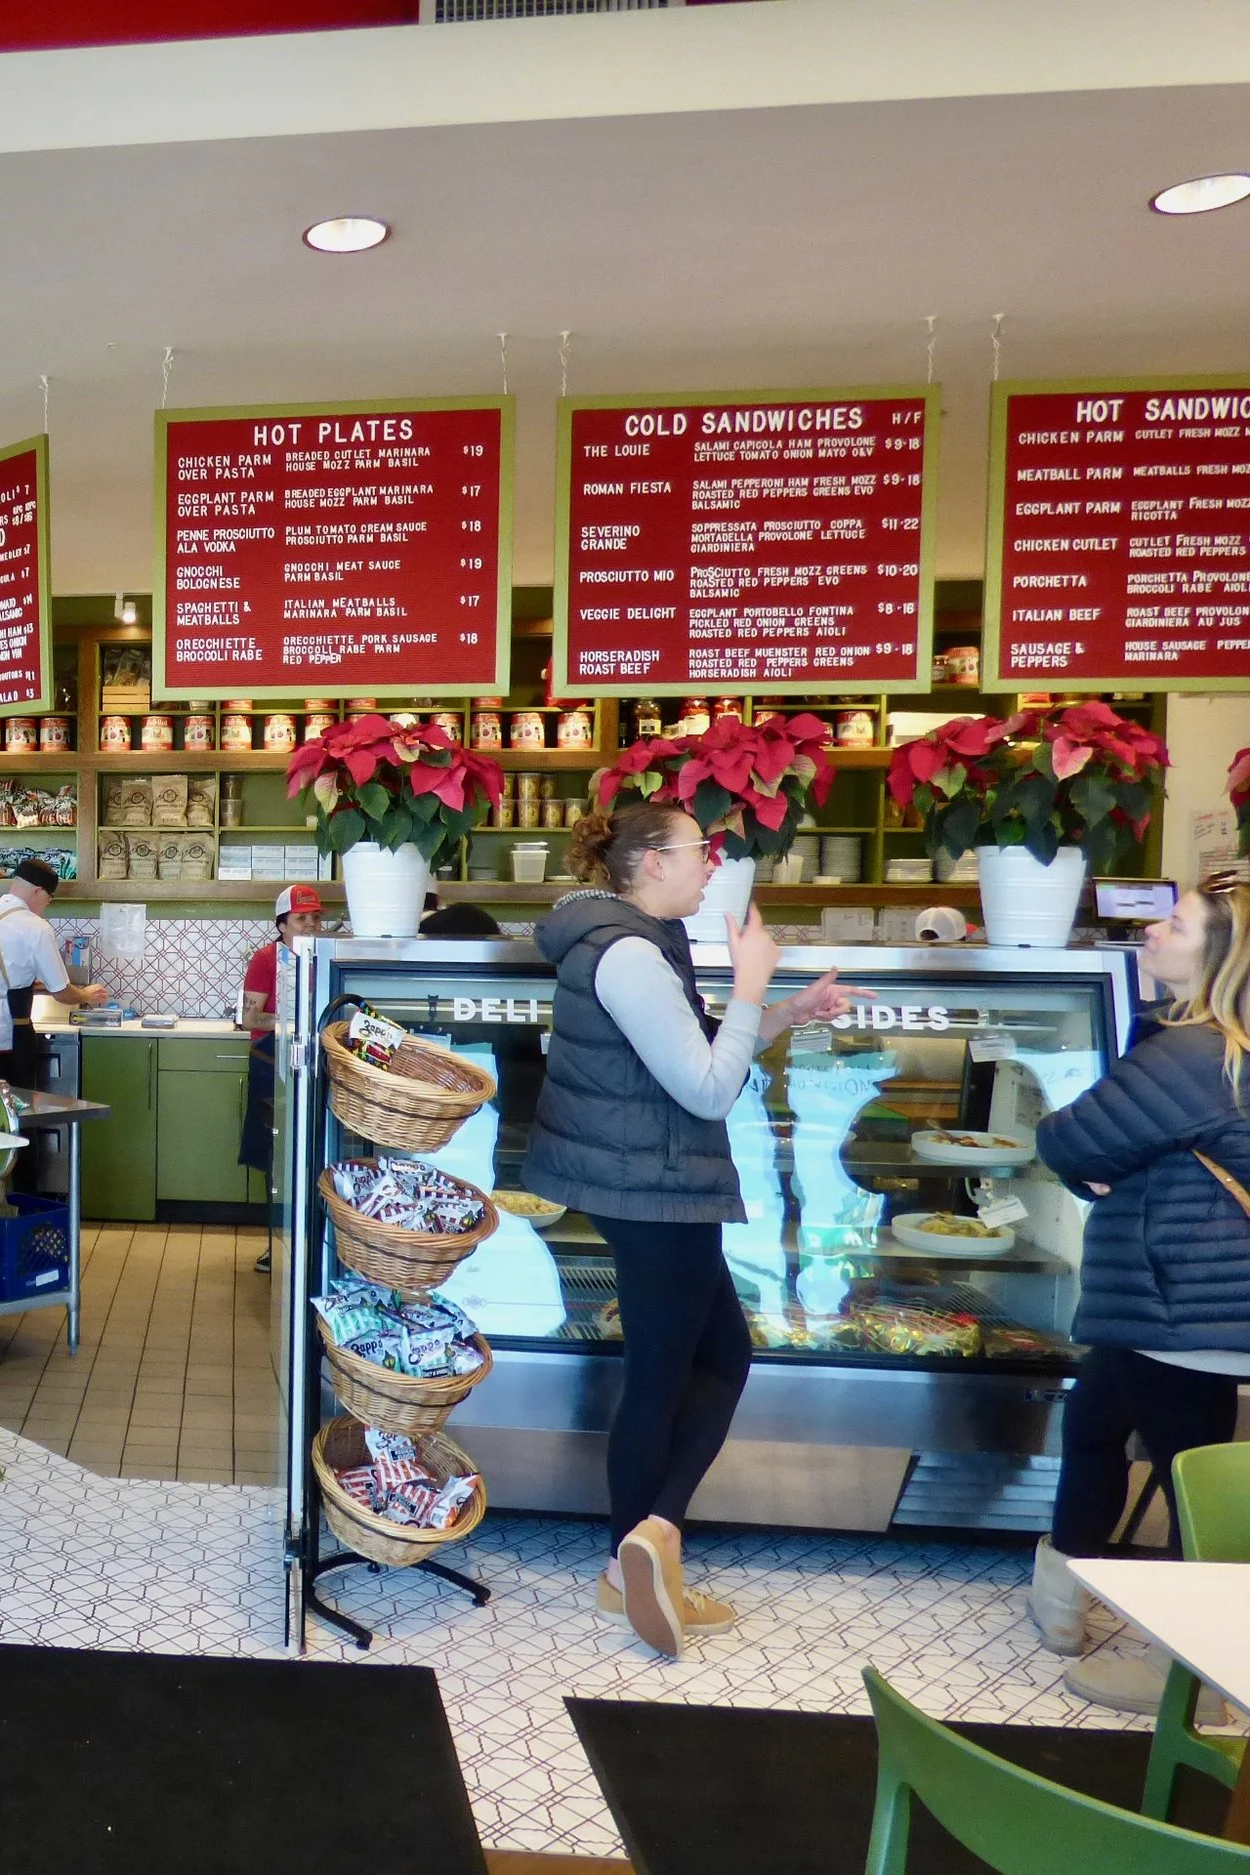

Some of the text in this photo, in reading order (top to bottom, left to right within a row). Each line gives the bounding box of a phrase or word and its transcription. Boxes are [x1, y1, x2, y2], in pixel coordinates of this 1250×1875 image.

[1077, 399, 1124, 423] HOT
[625, 407, 863, 436] COLD SANDWICHES
[254, 419, 413, 446] HOT PLATES
[1019, 430, 1124, 445] CHICKEN PARM
[286, 451, 330, 462] BREADED
[378, 447, 430, 458] MARINARA
[463, 445, 483, 457] $19
[584, 444, 650, 457] THE LOUIE
[178, 454, 271, 468] CHICKEN PARM
[286, 457, 419, 472] HOUSE MOZZ PARM BASIL
[178, 467, 255, 481] OVER PASTA
[1017, 467, 1123, 481] MEATBALL PARM
[285, 484, 433, 499] BREADED EGGPLANT MARINARA
[462, 485, 481, 497] $17
[583, 481, 671, 495] ROMAN FIESTA
[178, 491, 274, 505] EGGPLANT PARM
[285, 495, 414, 509] HOUSE MOZZ PARM BASIL
[692, 499, 740, 510] BALSAMIC
[178, 504, 255, 517] OVER PASTA
[1016, 501, 1121, 515] EGGPLANT PARM
[1131, 510, 1178, 521] RICOTTA
[286, 522, 427, 535] PLUM TOMATO CREAM SAUCE
[462, 520, 481, 532] $18
[581, 525, 640, 538] SEVERINO
[177, 527, 275, 541] PENNE PROSCIUTTO
[286, 533, 408, 545] PROSCIUTTO PARM BASIL
[177, 541, 236, 554] ALA VODKA
[581, 538, 627, 550] GRANDE
[1014, 538, 1118, 552] CHICKEN CUTLET
[284, 560, 401, 573] GNOCCHI MEAT SAUCE
[460, 558, 482, 569] $19
[176, 565, 223, 578] GNOCCHI
[284, 571, 344, 582] PARM BASIL
[580, 570, 674, 583] PROSCIUTTO MIO
[176, 577, 240, 590] BOLOGNESE
[1013, 575, 1087, 588] PORCHETTA
[690, 588, 740, 598] BALSAMIC
[177, 601, 251, 614] SPAGHETTI &
[285, 597, 395, 609] ITALIAN MEATBALLS
[460, 595, 480, 607] $17
[284, 607, 407, 619] MARINARA PARM BASIL
[580, 607, 676, 620] VEGGIE DELIGHT
[1013, 608, 1101, 621] ITALIAN BEEF
[177, 614, 240, 626] MEATBALLS
[176, 637, 256, 650] ORECCHIETTE
[283, 633, 437, 646] ORECCHIETTE PORK SAUSAGE
[460, 633, 478, 644] $18
[283, 644, 400, 655] BROCCOLI RABE PARM
[1011, 642, 1085, 655] SAUSAGE &
[176, 649, 262, 662] BROCCOLI RABE
[283, 651, 342, 665] RED PEPPER
[580, 650, 660, 663] HORSERADISH
[1011, 655, 1068, 668] PEPPERS
[1125, 651, 1179, 661] MARINARA
[579, 662, 651, 675] ROAST BEEF
[689, 668, 792, 678] HORSERADISH AIOLI
[453, 997, 539, 1024] DELI
[831, 1004, 951, 1032] SIDES
